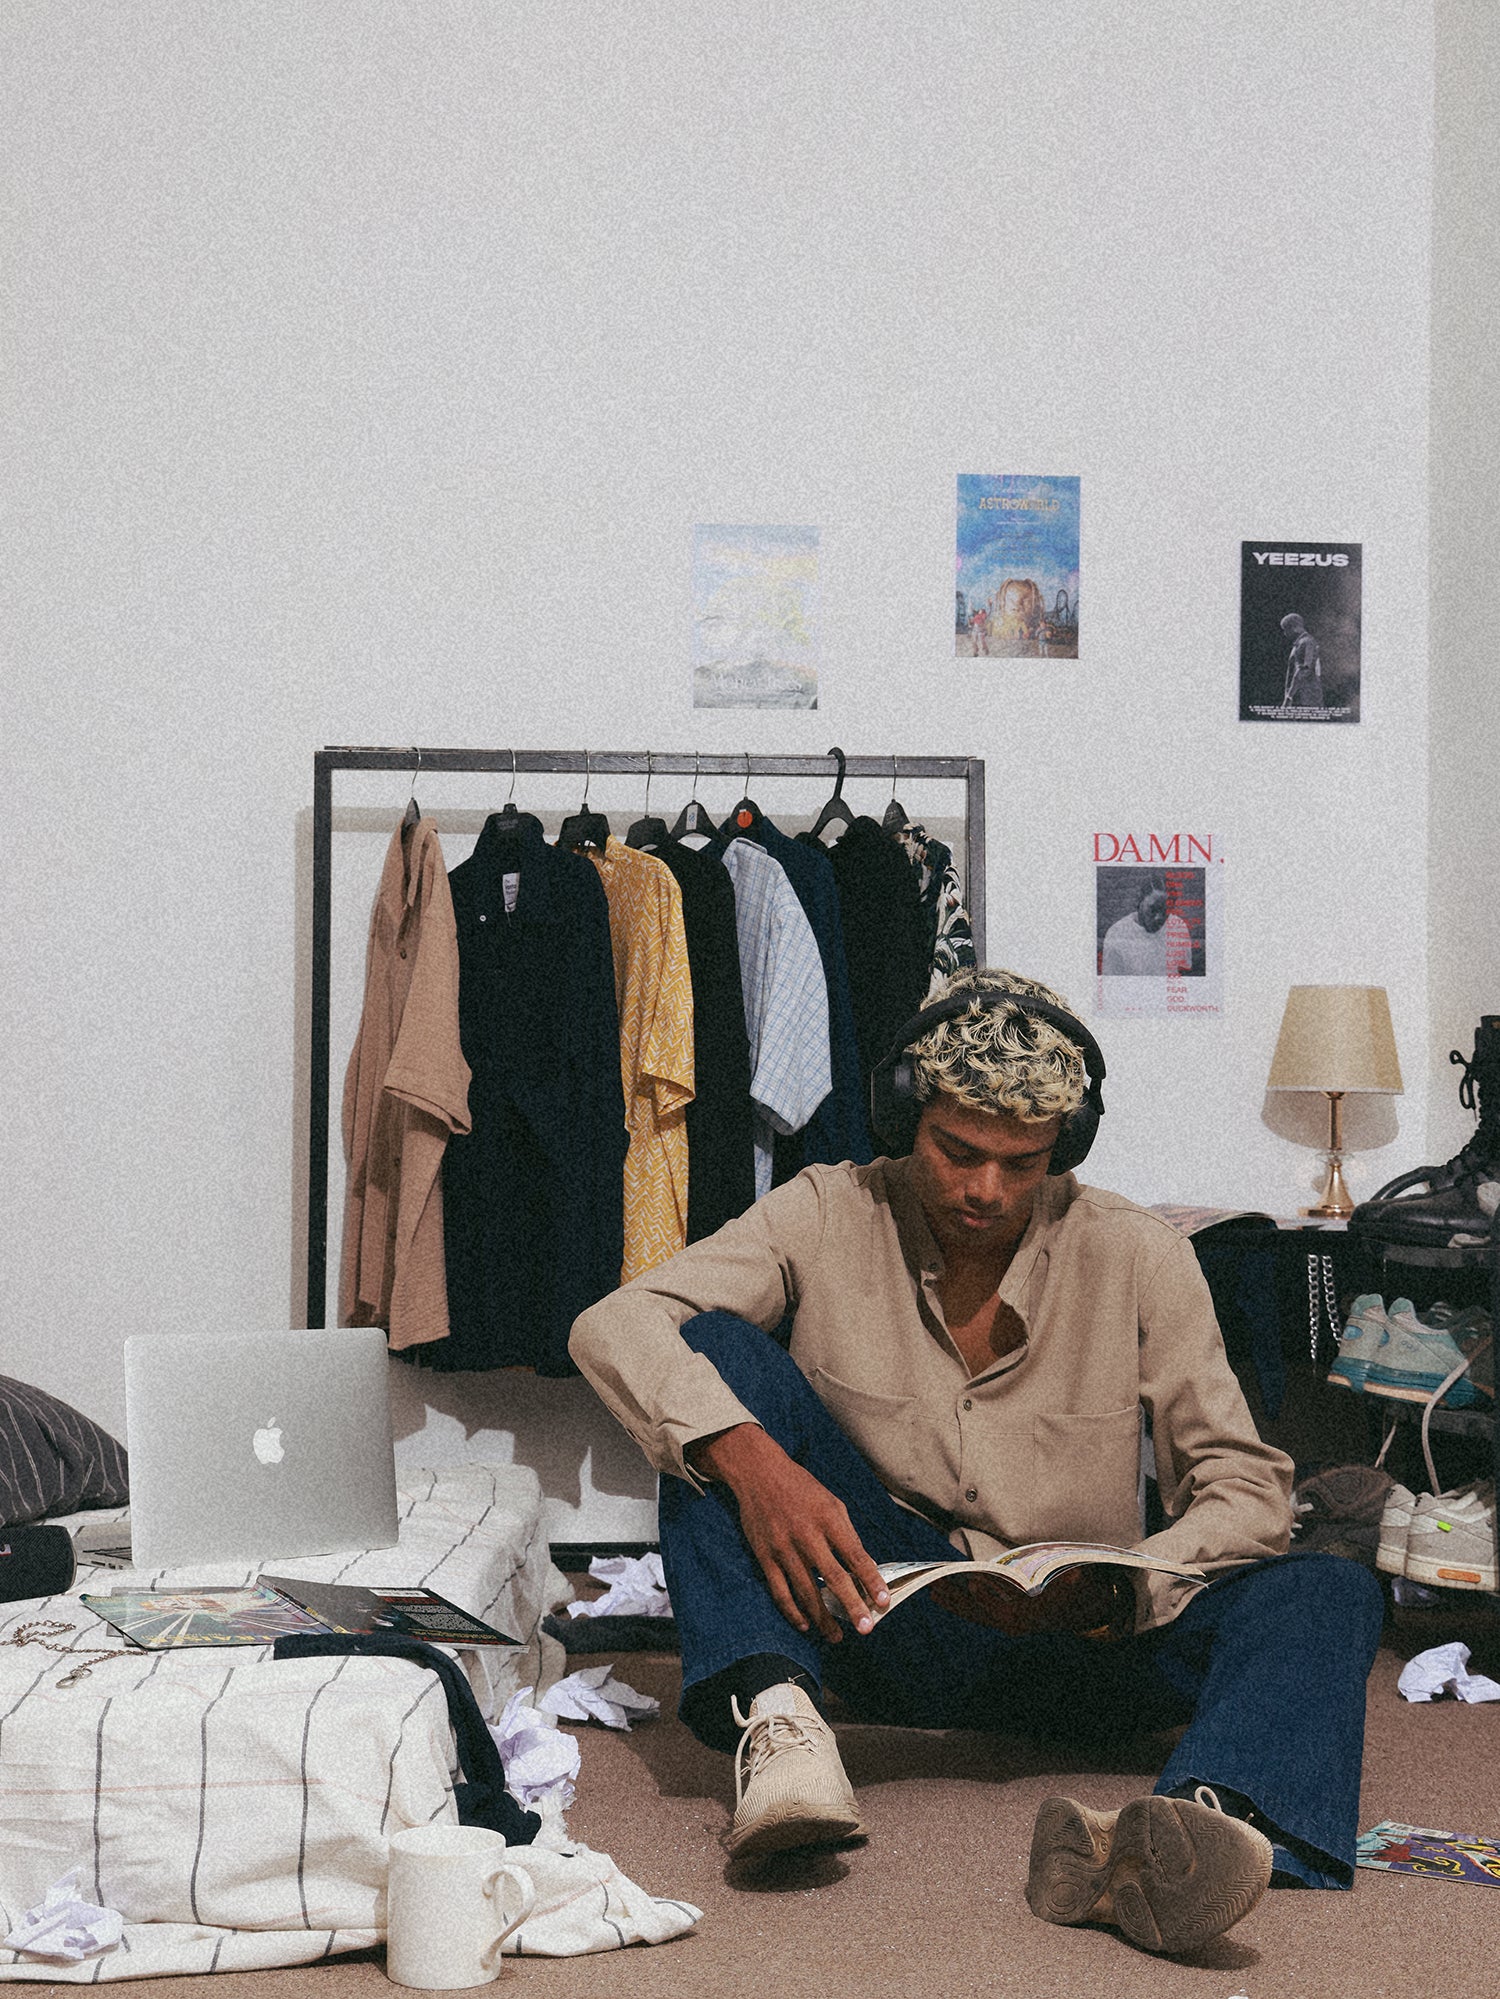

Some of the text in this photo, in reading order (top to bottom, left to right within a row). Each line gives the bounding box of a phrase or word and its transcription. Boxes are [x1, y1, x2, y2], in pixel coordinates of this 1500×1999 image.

[979, 497, 1060, 511] ASTROWRLD
[1252, 552, 1349, 567] YEEZUS
[1093, 833, 1224, 863] DAMN.
